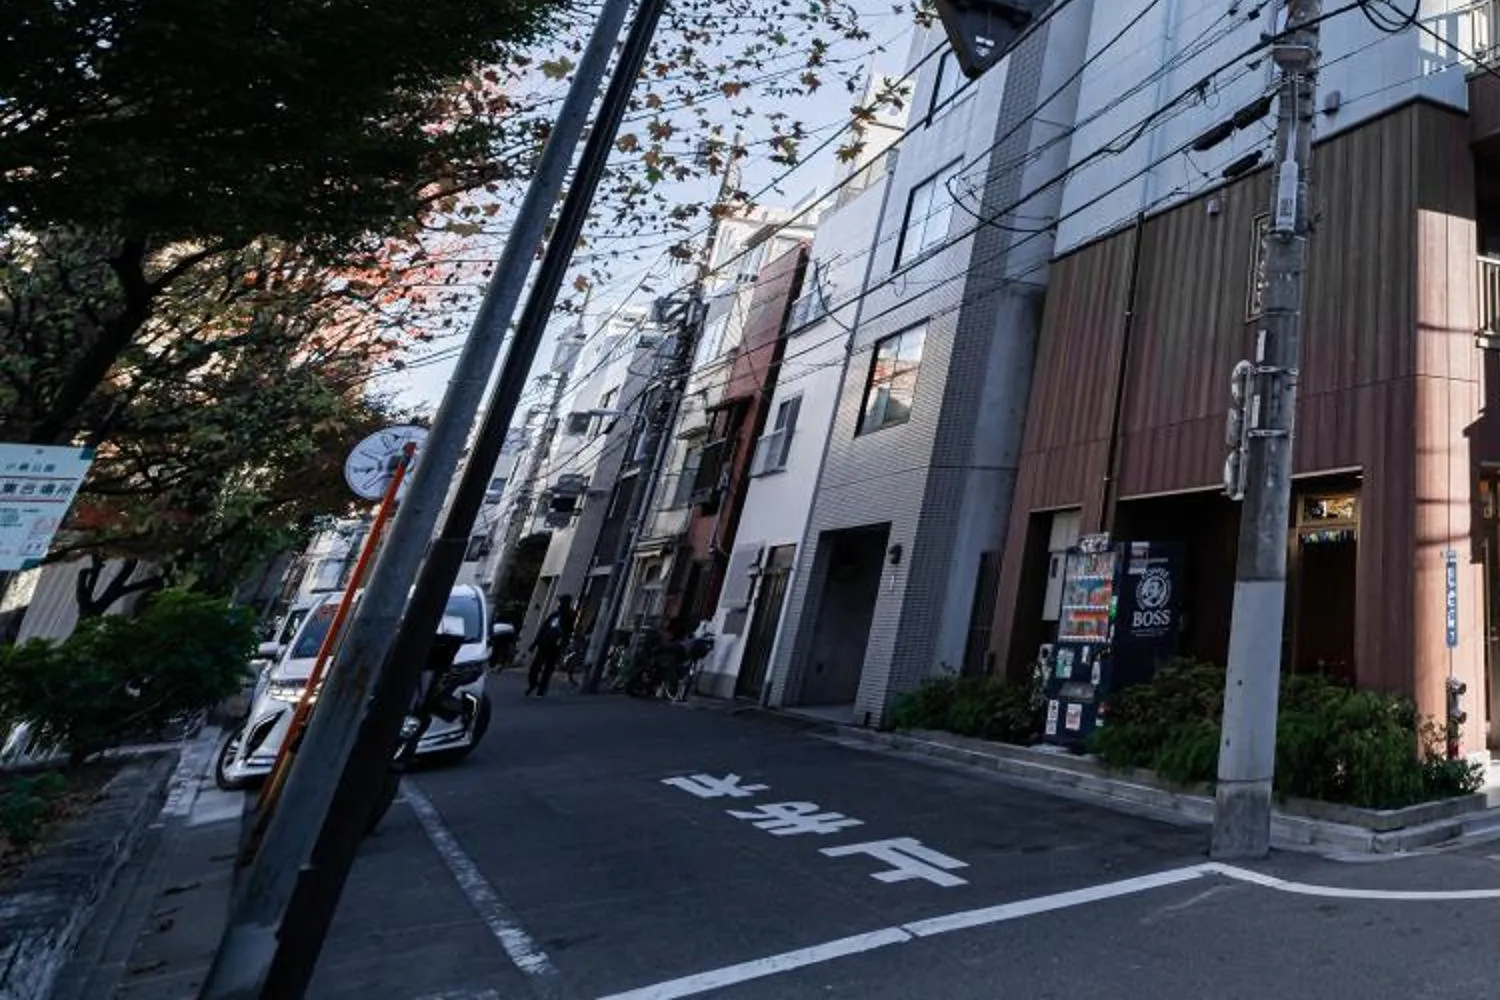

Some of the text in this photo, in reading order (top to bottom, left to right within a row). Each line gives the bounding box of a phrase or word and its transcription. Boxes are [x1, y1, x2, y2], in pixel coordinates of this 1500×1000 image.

[1131, 609, 1170, 627] BOSS
[661, 773, 971, 887] 止まれ
